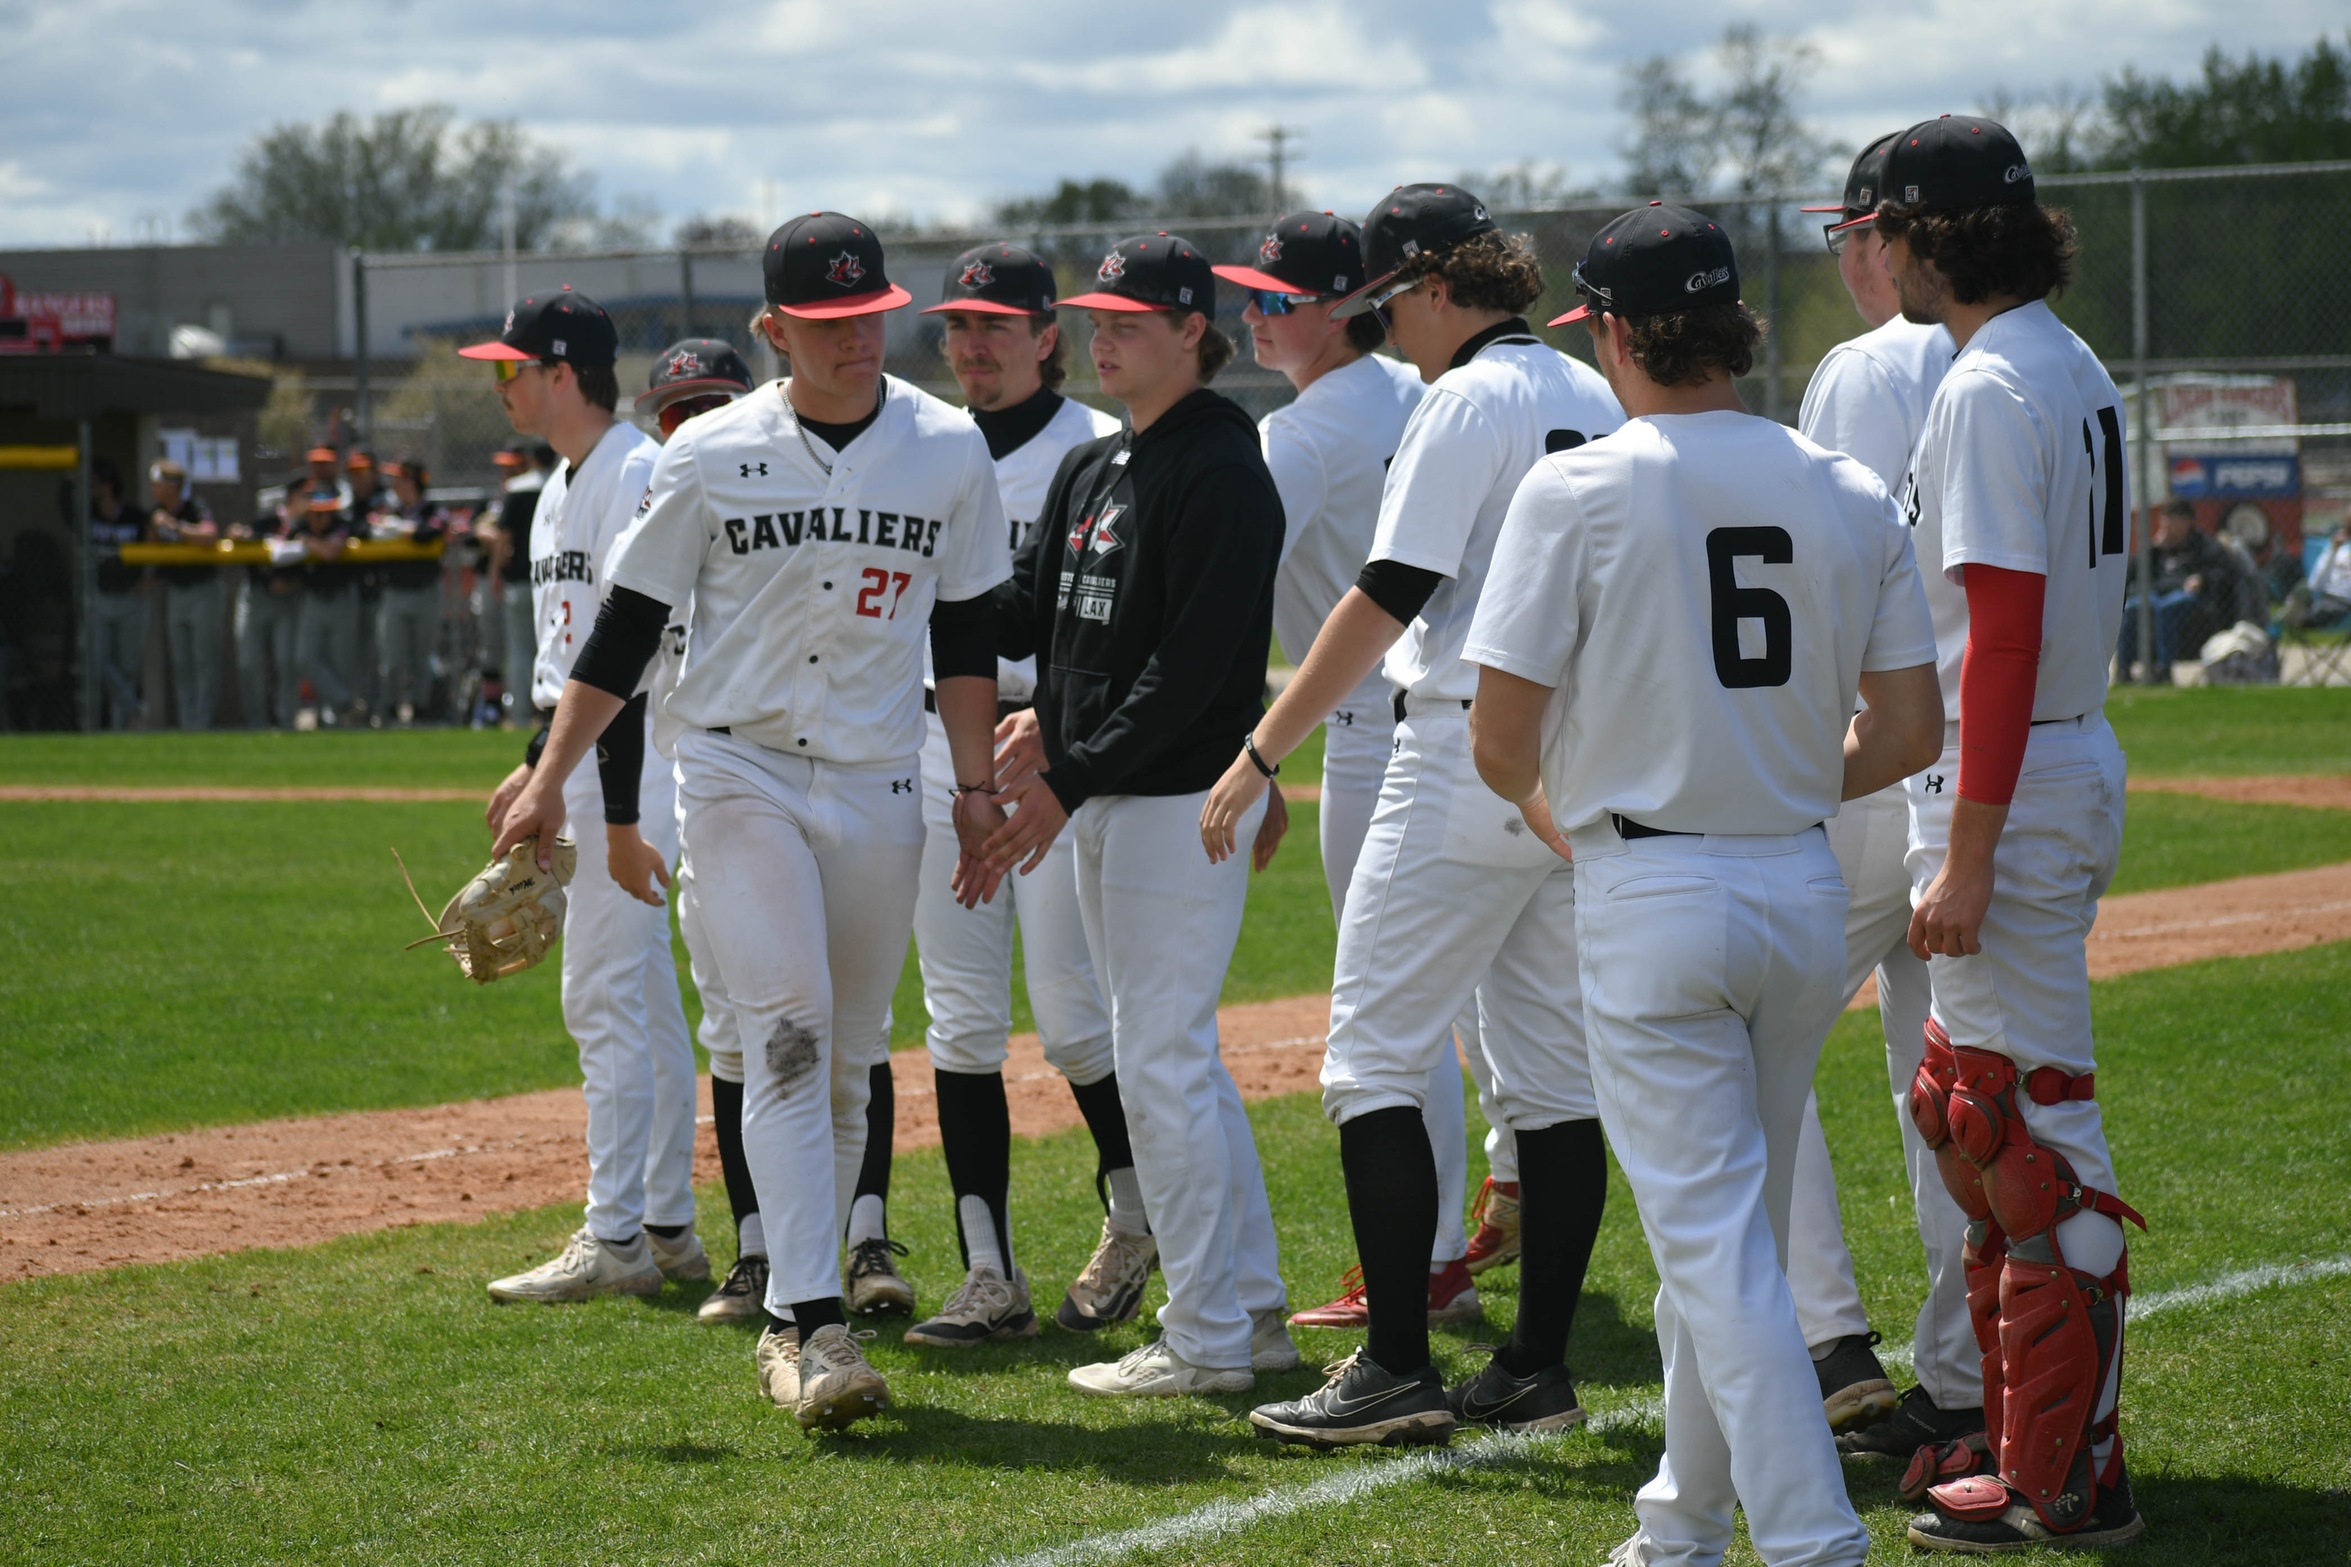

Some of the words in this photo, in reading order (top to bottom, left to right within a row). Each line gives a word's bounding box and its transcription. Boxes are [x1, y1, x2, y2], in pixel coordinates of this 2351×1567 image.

[725, 507, 942, 558] CAVALIERS
[2083, 406, 2124, 570] 11
[856, 567, 912, 620] 27
[1706, 526, 1793, 689] 6
